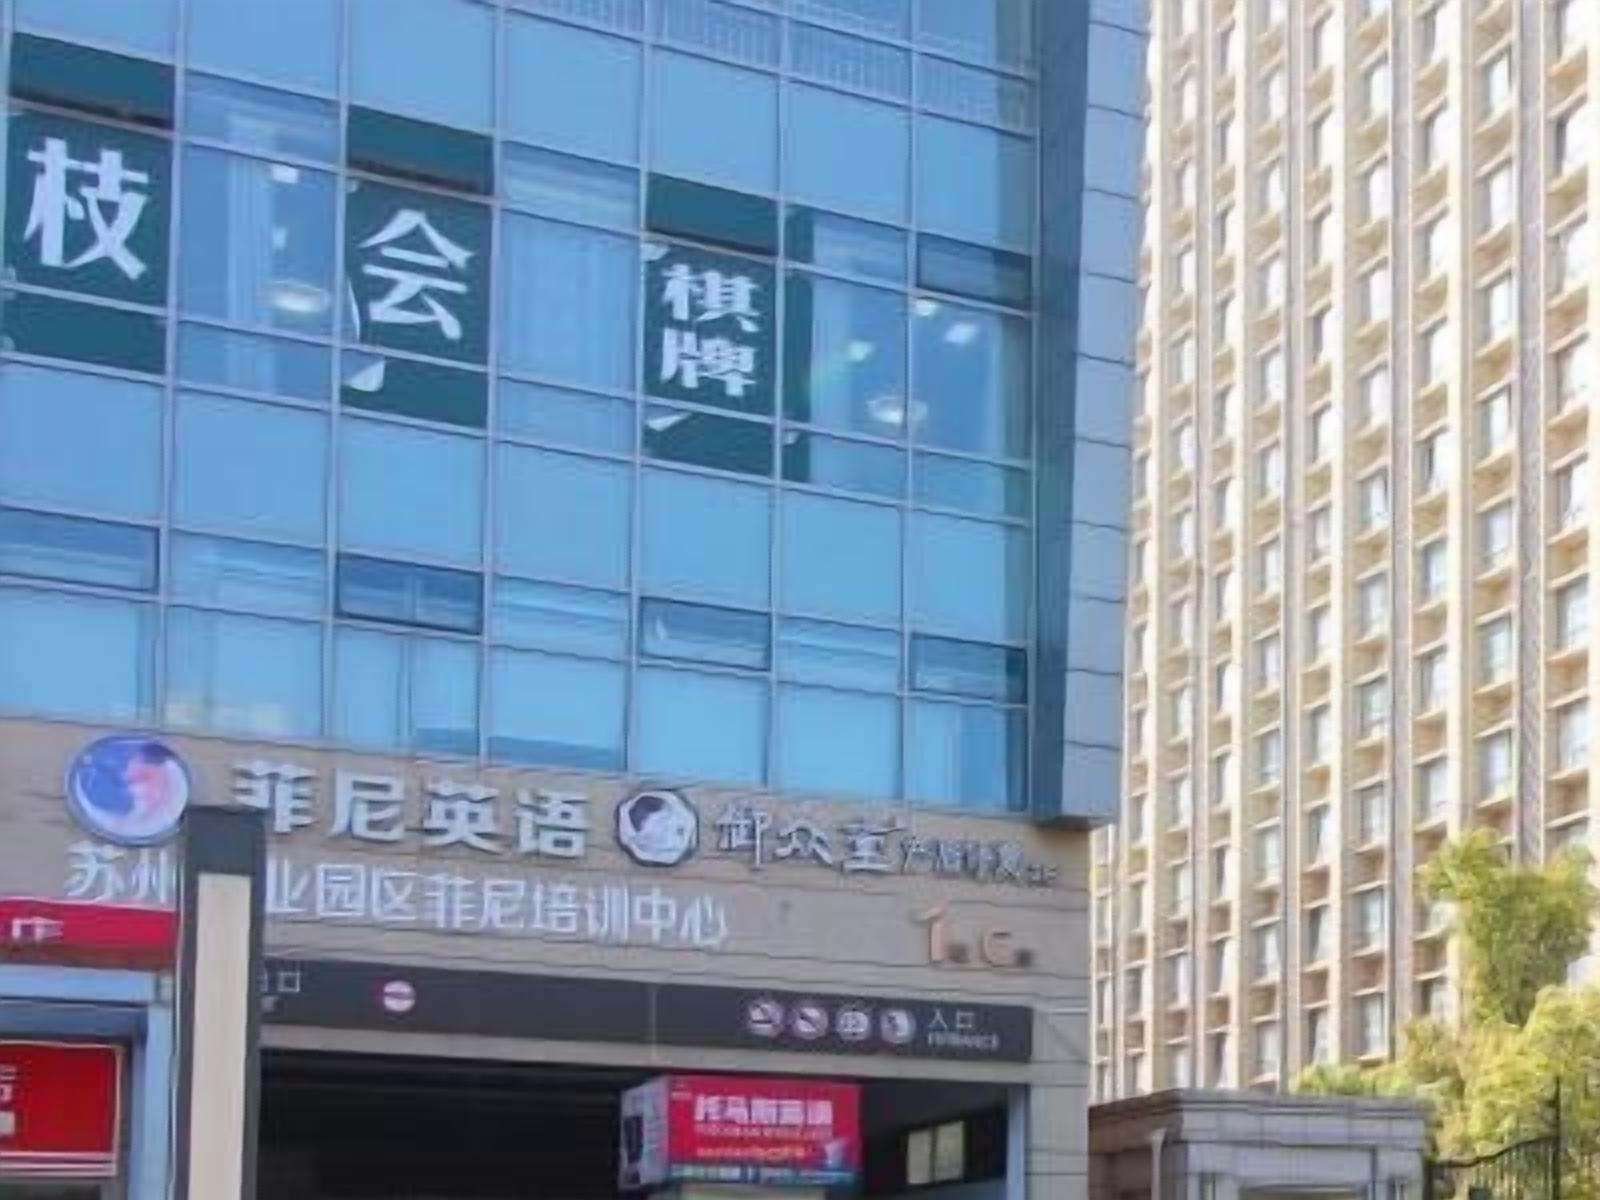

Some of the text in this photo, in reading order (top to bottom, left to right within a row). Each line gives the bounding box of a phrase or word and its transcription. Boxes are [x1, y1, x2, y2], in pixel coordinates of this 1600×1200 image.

[24, 137, 761, 397] 枝 会 棋牌
[230, 760, 592, 860] 菲尼英语
[64, 842, 730, 948] 苏州业园区菲尼培训中心
